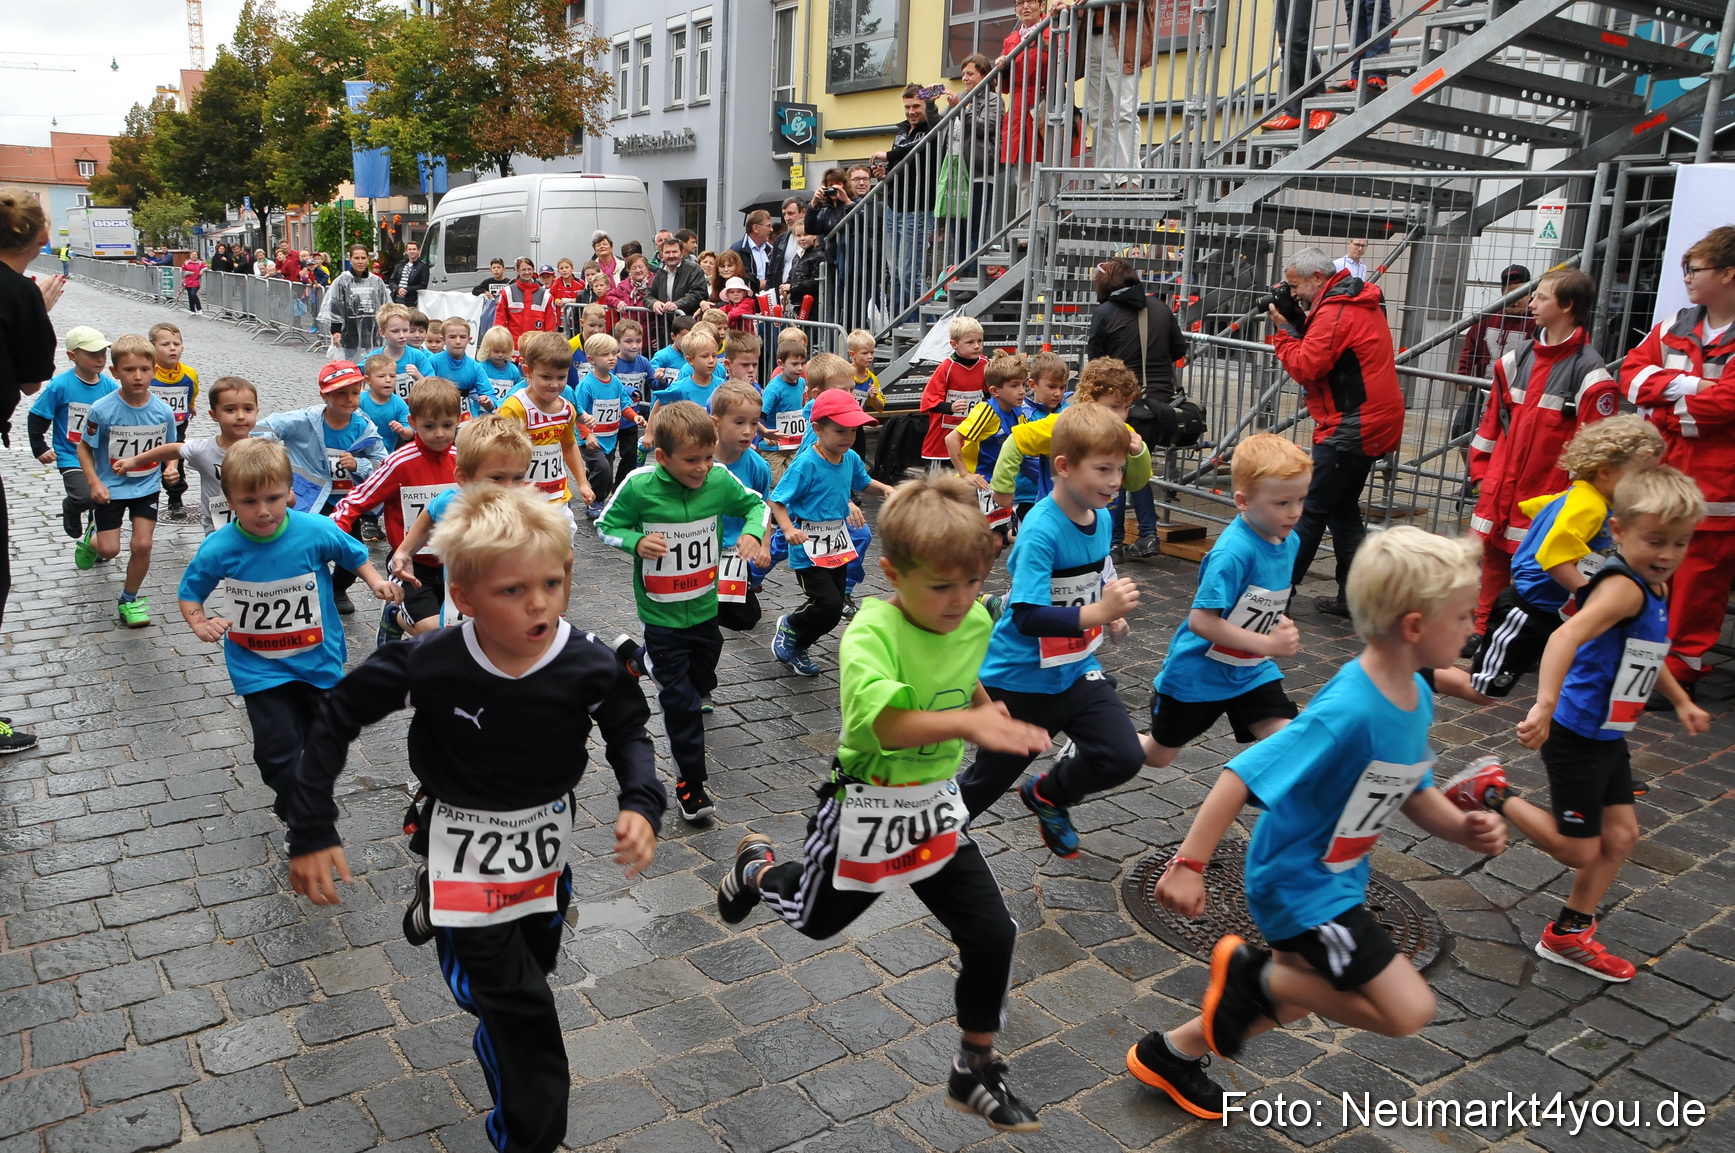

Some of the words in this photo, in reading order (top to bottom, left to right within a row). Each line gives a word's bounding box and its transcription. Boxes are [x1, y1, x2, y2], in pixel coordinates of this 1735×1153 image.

[161, 397, 185, 411] 94
[111, 430, 133, 438] PARTL
[134, 429, 161, 437] Neumarkt
[529, 456, 562, 479] 7134
[674, 527, 709, 539] Neumarkt
[808, 530, 848, 554] 7140
[225, 586, 255, 598] PARTL
[257, 584, 302, 598] Neumarkt
[674, 577, 698, 591] Felix
[1245, 592, 1272, 606] PARTL
[234, 596, 313, 630] 7224
[248, 635, 303, 649] Benedikt
[846, 797, 890, 809] PARTL
[893, 790, 945, 808] Neumarkt
[437, 806, 485, 824] PARTL
[490, 807, 548, 828] Neumarkt
[447, 822, 560, 875] 7236
